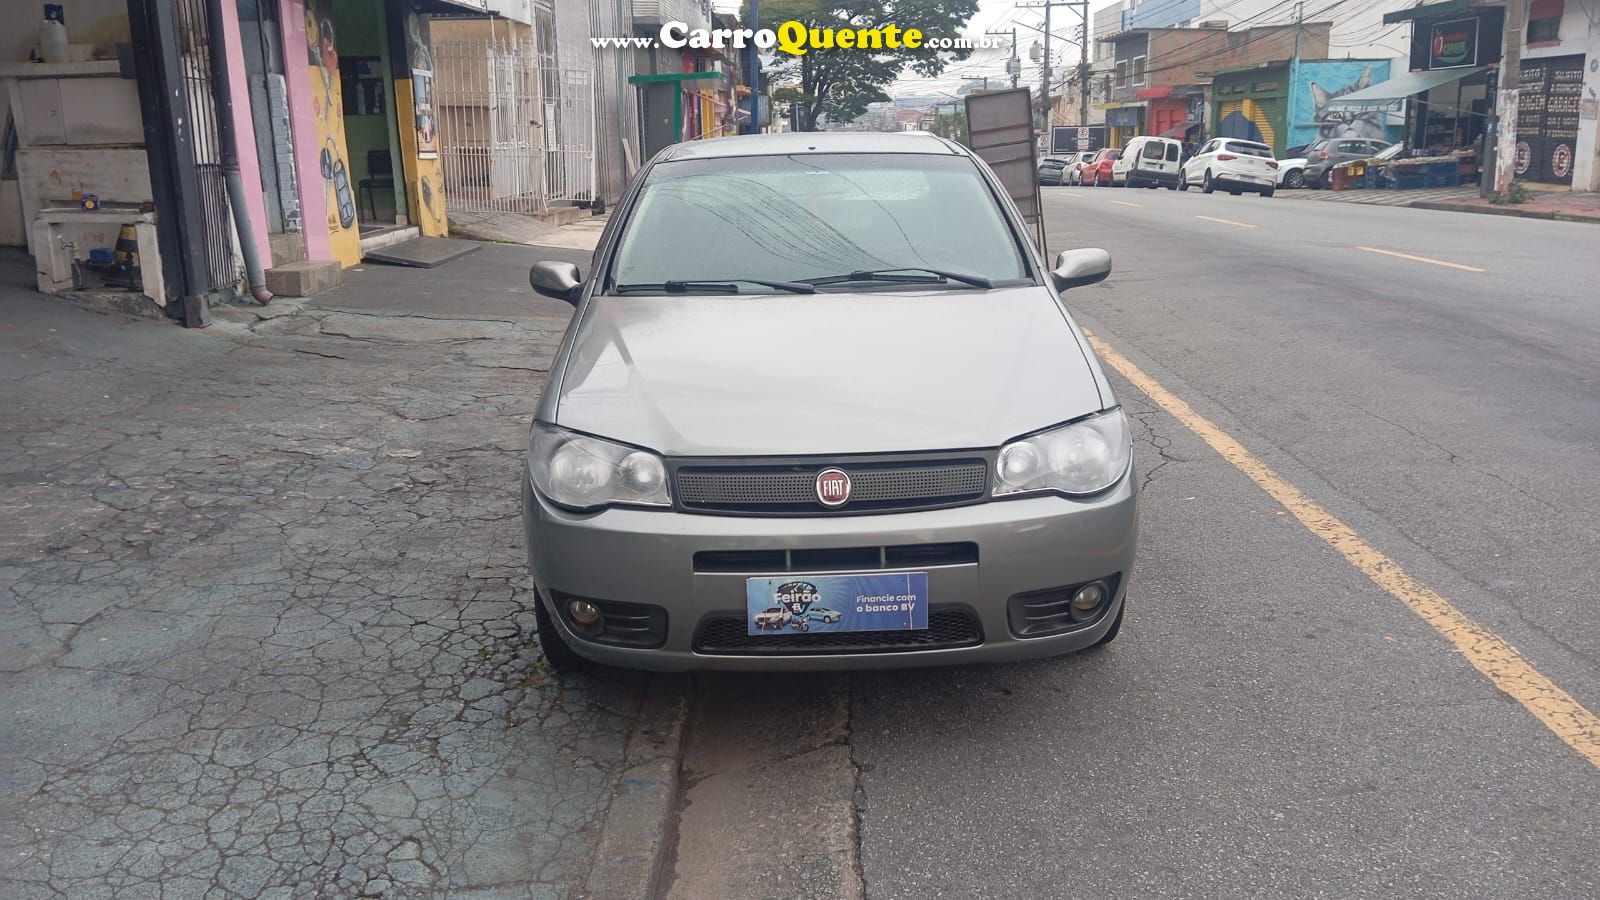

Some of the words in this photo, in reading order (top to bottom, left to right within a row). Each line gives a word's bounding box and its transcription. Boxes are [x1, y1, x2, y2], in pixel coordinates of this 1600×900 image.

[823, 480, 844, 497] FIAT
[773, 590, 822, 605] Feirão
[856, 594, 895, 603] Financie
[865, 604, 899, 612] banco
[901, 603, 916, 611] BV
